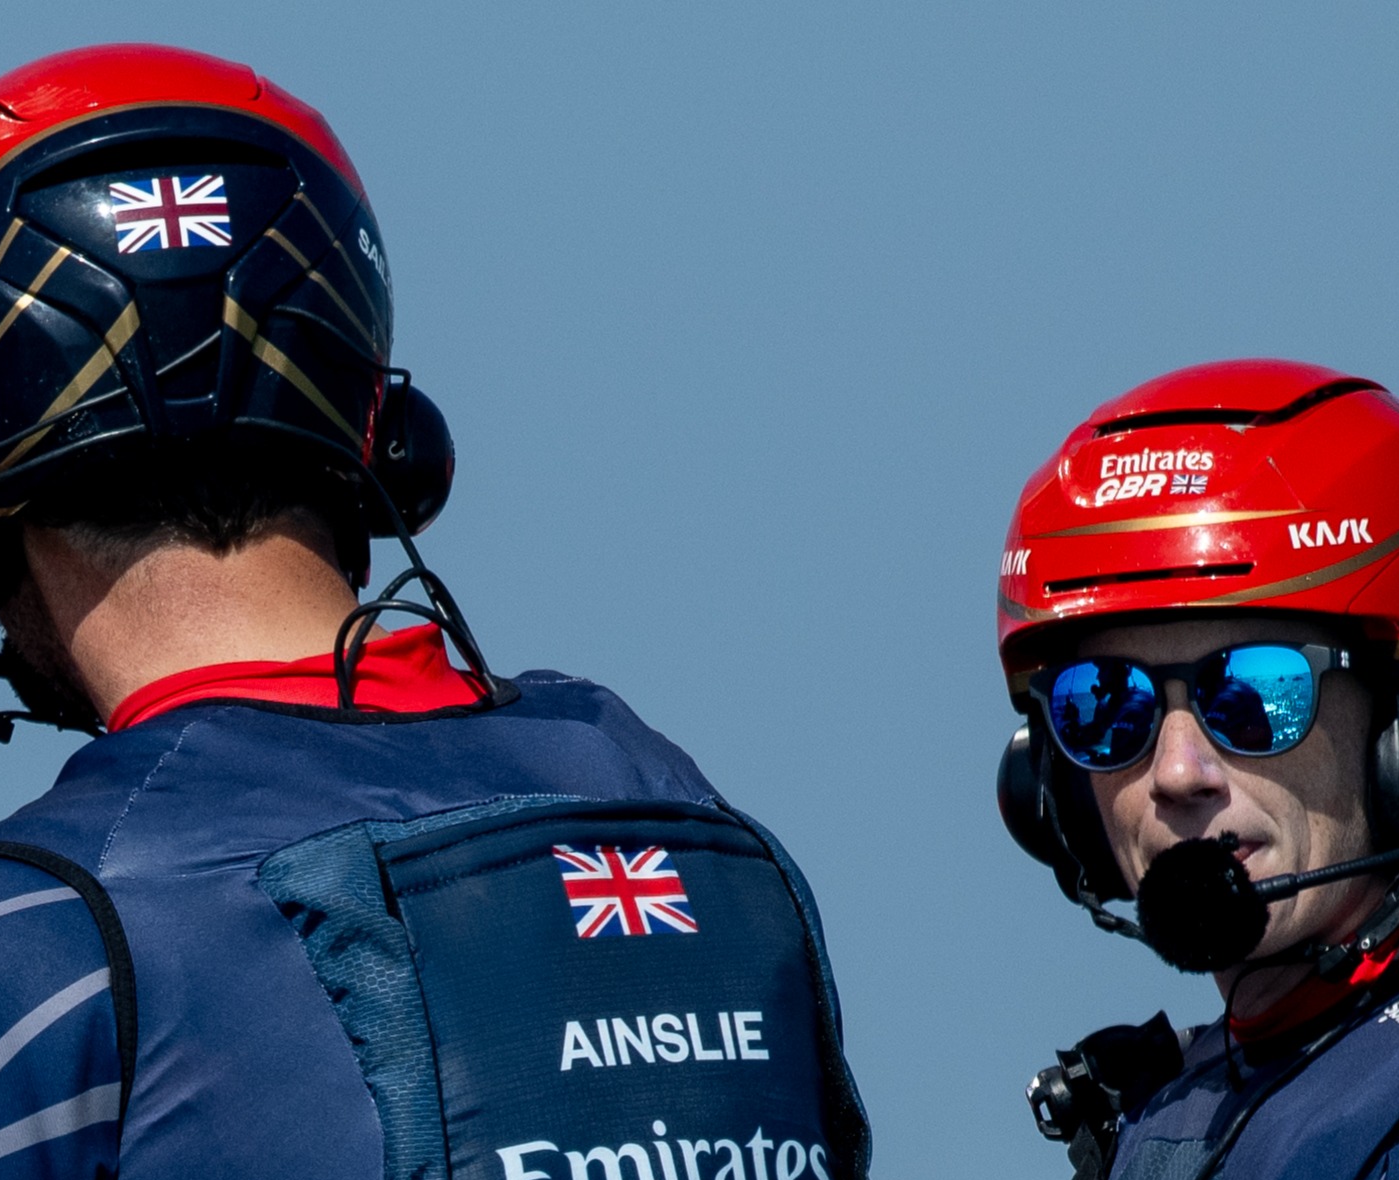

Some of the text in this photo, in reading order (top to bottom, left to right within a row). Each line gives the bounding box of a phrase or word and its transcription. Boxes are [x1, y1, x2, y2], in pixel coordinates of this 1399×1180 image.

[1100, 447, 1214, 479] Emirates
[1094, 473, 1167, 505] GBR
[1288, 517, 1374, 550] KASK
[560, 1010, 770, 1072] AINSLIE
